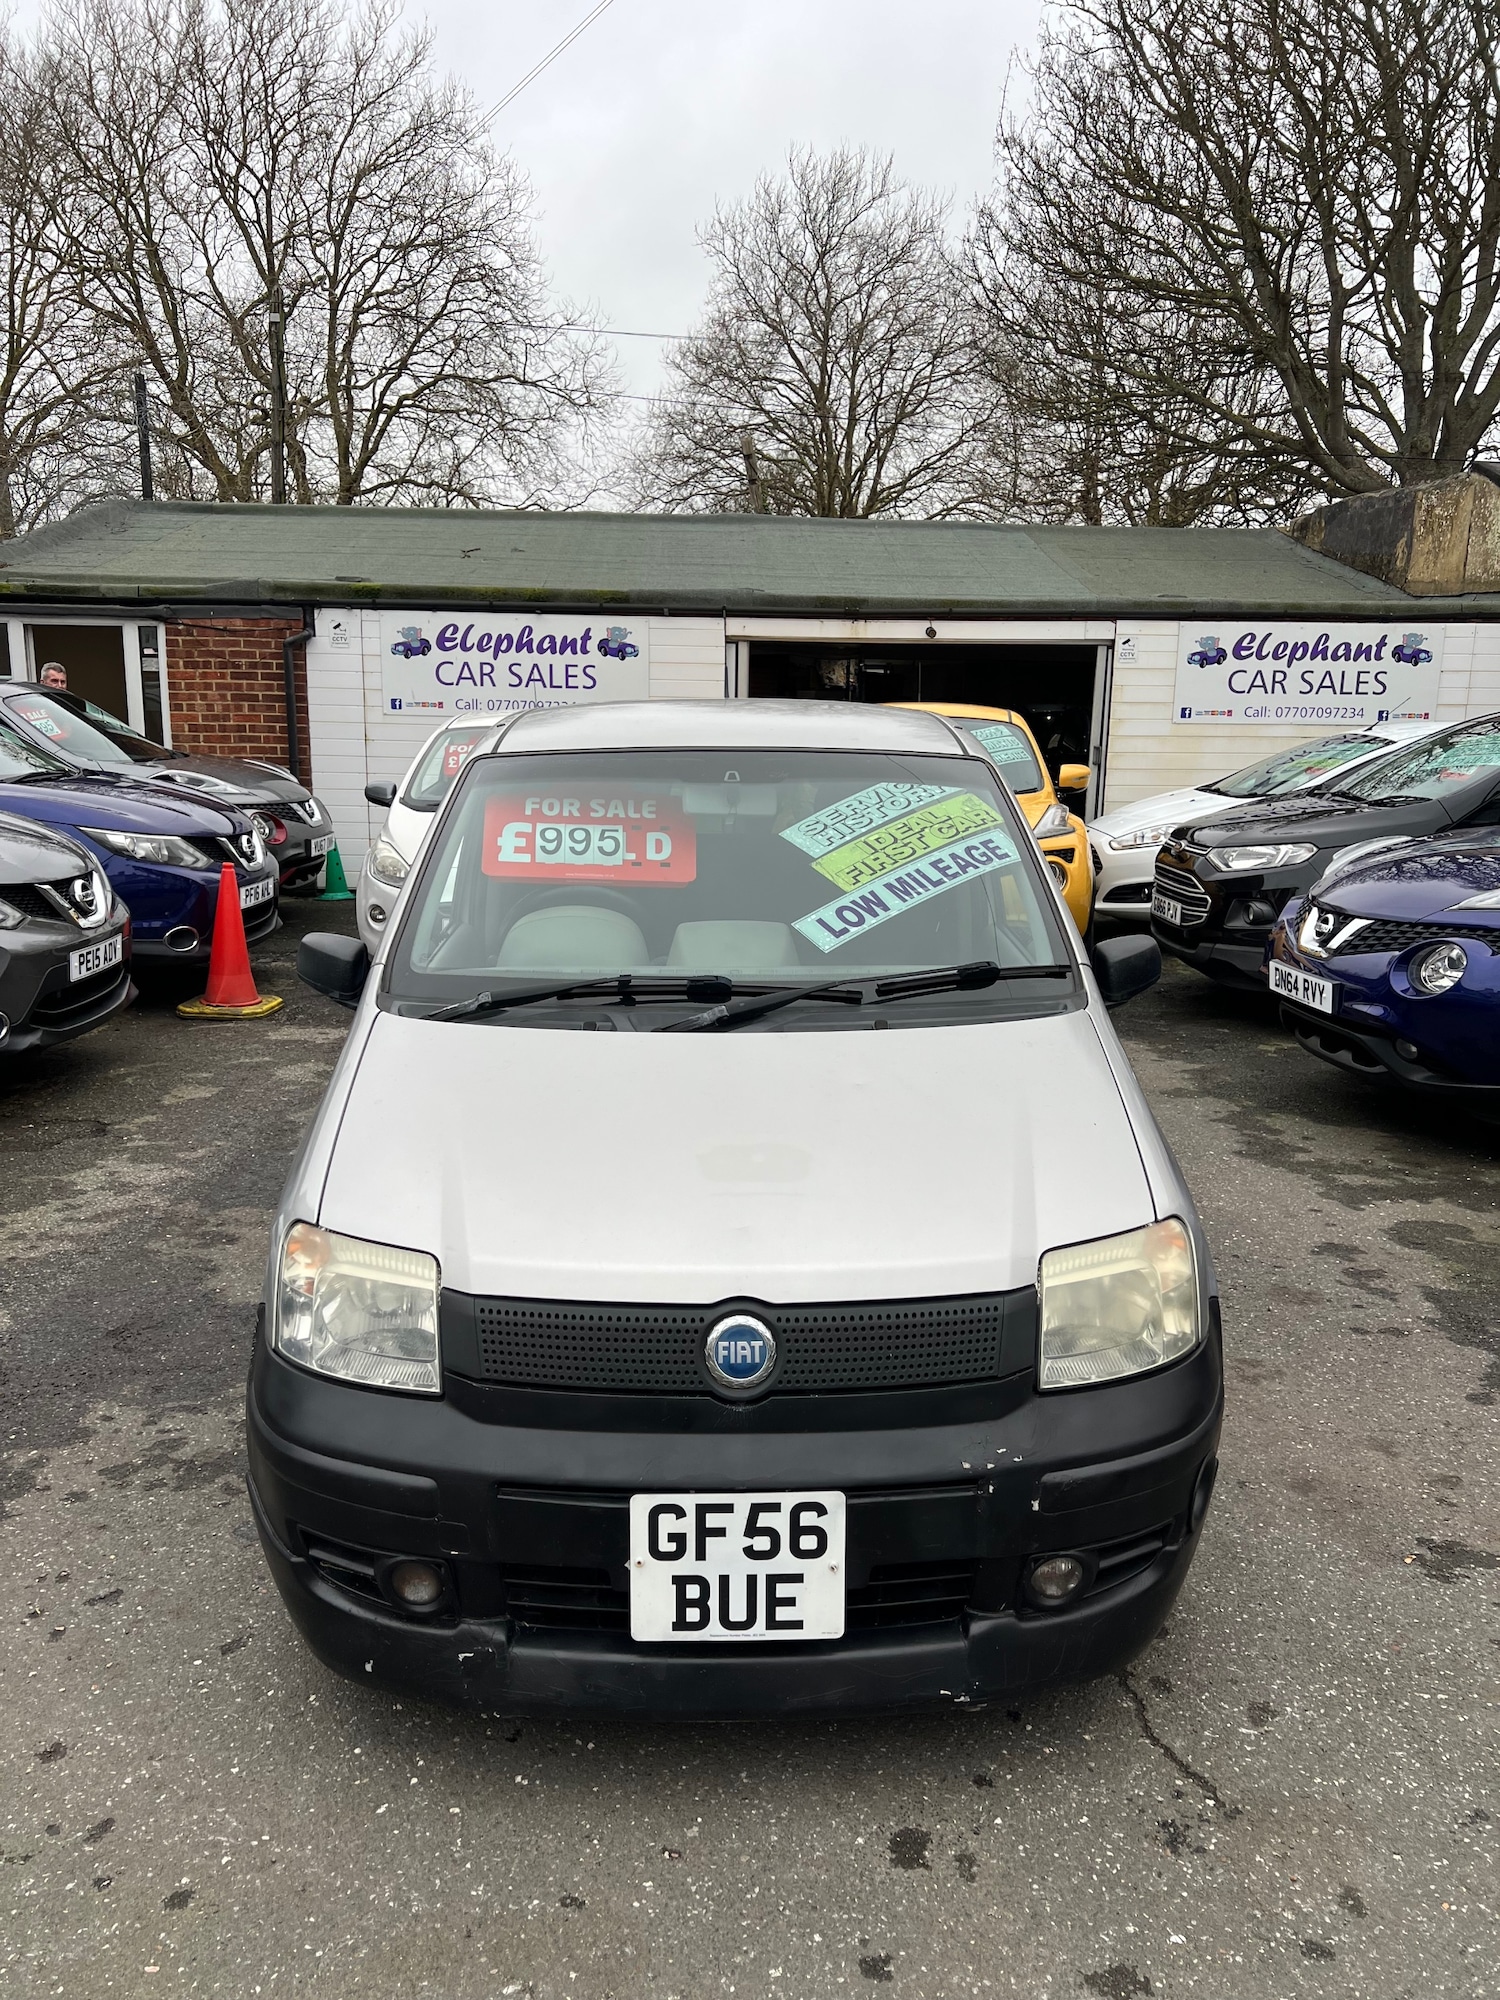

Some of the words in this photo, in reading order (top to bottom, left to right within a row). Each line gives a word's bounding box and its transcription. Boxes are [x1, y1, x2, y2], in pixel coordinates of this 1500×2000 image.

[435, 623, 592, 660] Elephant
[1232, 632, 1388, 668] Elephant
[435, 661, 496, 687] CAR
[508, 663, 597, 690] SALES
[1227, 669, 1288, 694] CAR
[1299, 671, 1388, 695] SALES
[455, 699, 483, 711] Call:
[487, 699, 576, 711] 07707097
[1244, 706, 1271, 718] Call:
[1275, 706, 1365, 719] 07707097234
[524, 797, 581, 818] FOR
[590, 798, 657, 819] SALE
[797, 782, 914, 837] SERVIC
[497, 821, 621, 863] £995
[836, 834, 931, 886] FIRST
[930, 808, 999, 840] CAR
[854, 810, 951, 856] IDEAL
[815, 889, 891, 939] LOW
[886, 838, 1012, 903] MILEAGE
[79, 947, 101, 975] PE15
[1275, 966, 1299, 996] DN64
[1303, 978, 1325, 1006] RVY
[717, 1340, 764, 1364] FIAT
[648, 1501, 829, 1561] GF56
[671, 1573, 804, 1632] BUE
